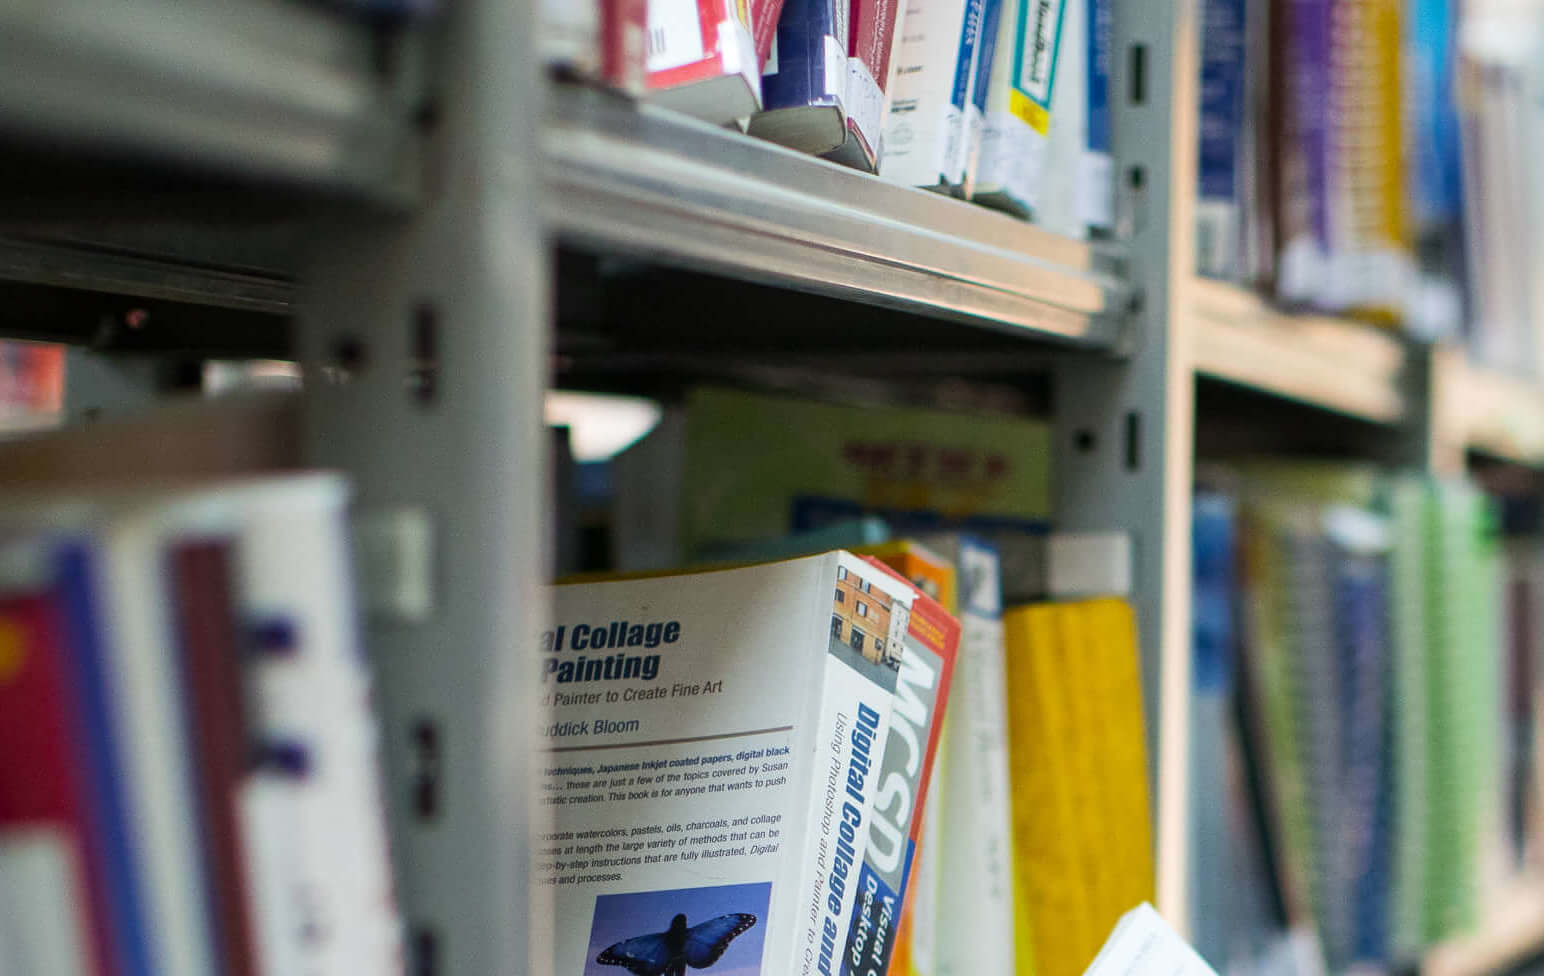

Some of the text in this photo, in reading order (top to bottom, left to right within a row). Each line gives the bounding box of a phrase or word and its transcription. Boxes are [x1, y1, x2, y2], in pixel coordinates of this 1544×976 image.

[570, 621, 681, 650] Collage
[542, 653, 661, 684] Painting
[554, 693, 601, 707] Painter
[606, 690, 619, 703] to
[623, 686, 667, 702] Create
[672, 683, 700, 697] Fine
[703, 680, 722, 694] Art
[542, 718, 640, 737] uddick Bloom
[830, 712, 847, 755] Using
[597, 763, 640, 774] Japanese
[669, 757, 700, 768] coated
[701, 754, 733, 766] papers,
[735, 748, 764, 761] digital
[766, 746, 790, 757] black
[845, 701, 880, 804] Digital
[866, 646, 936, 874] MCSD
[592, 780, 607, 788] are
[609, 777, 626, 789] just
[636, 775, 653, 785] few
[655, 774, 665, 784] of
[667, 773, 681, 783] the
[684, 769, 710, 781] topics
[712, 766, 746, 778] covered
[749, 765, 760, 776] by
[762, 762, 789, 773] Susan
[609, 792, 626, 801] This
[628, 790, 650, 800] book
[651, 789, 659, 798] is
[661, 787, 673, 797] for
[675, 785, 706, 797] anyone
[708, 782, 725, 793] that
[727, 780, 753, 791] wants
[755, 778, 764, 788] to
[765, 776, 787, 788] push
[820, 756, 842, 836] Photoshop
[564, 846, 574, 855] at
[575, 843, 603, 856] length
[605, 842, 620, 852] the
[621, 840, 645, 852] large
[647, 837, 676, 850] variety
[678, 836, 689, 847] of
[690, 833, 727, 845] methods
[730, 831, 747, 841] that
[749, 830, 766, 840] can
[768, 828, 780, 838] be
[575, 827, 628, 840] watercolors,
[630, 824, 664, 837] pastels,
[666, 823, 683, 833] oils,
[685, 818, 730, 831] charcoals,
[732, 816, 749, 827] and
[750, 814, 782, 826] collage
[591, 855, 642, 868] instructions
[644, 854, 662, 864] that
[663, 853, 678, 863] are
[680, 850, 699, 861] fully
[750, 843, 780, 855] Digital
[817, 838, 829, 870] and
[827, 801, 862, 916] Collage
[558, 875, 576, 885] and
[576, 873, 623, 885] processes.
[810, 870, 825, 925] Painter
[852, 874, 878, 967] Desktop
[871, 895, 895, 966] Visual
